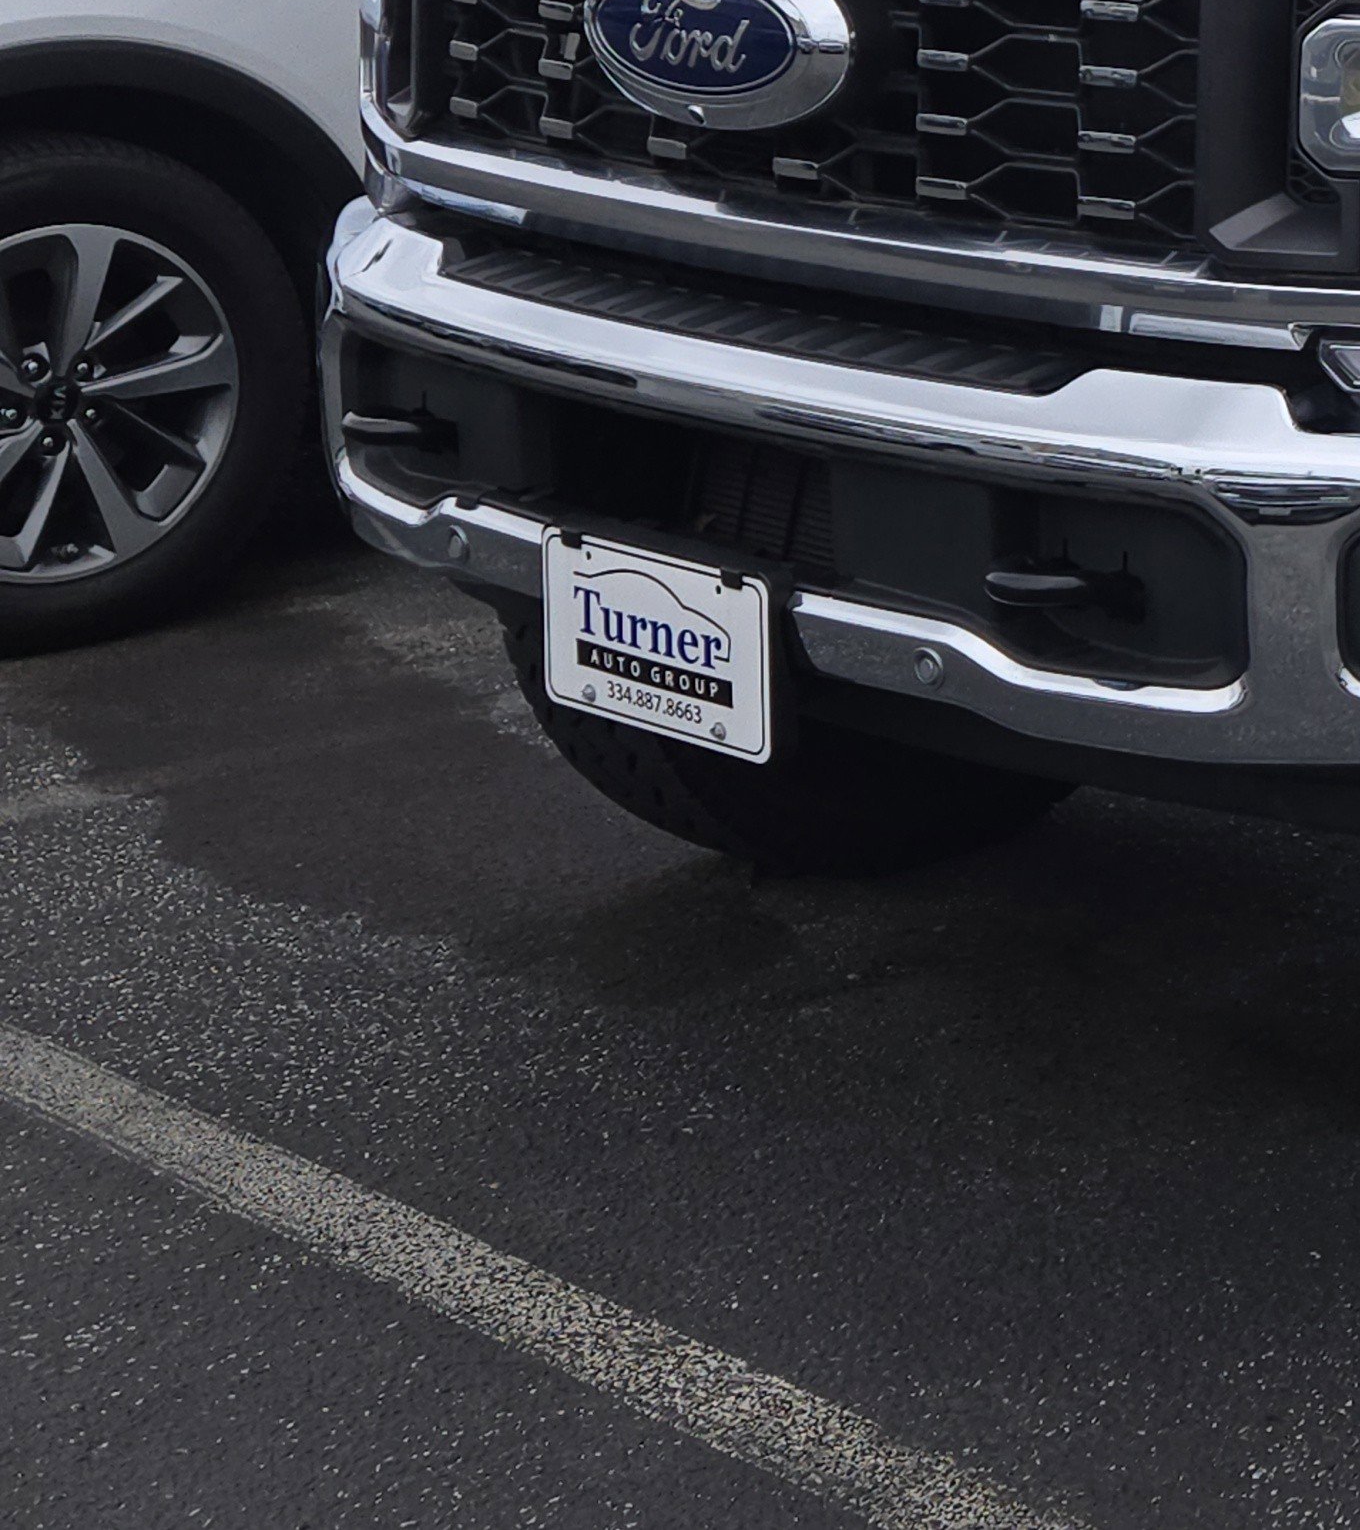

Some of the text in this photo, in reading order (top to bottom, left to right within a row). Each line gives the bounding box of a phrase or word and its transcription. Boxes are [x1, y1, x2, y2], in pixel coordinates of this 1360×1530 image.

[573, 585, 722, 670] Turner
[590, 648, 720, 698] AUTO GROUP
[606, 680, 703, 725] 334.887.8663
